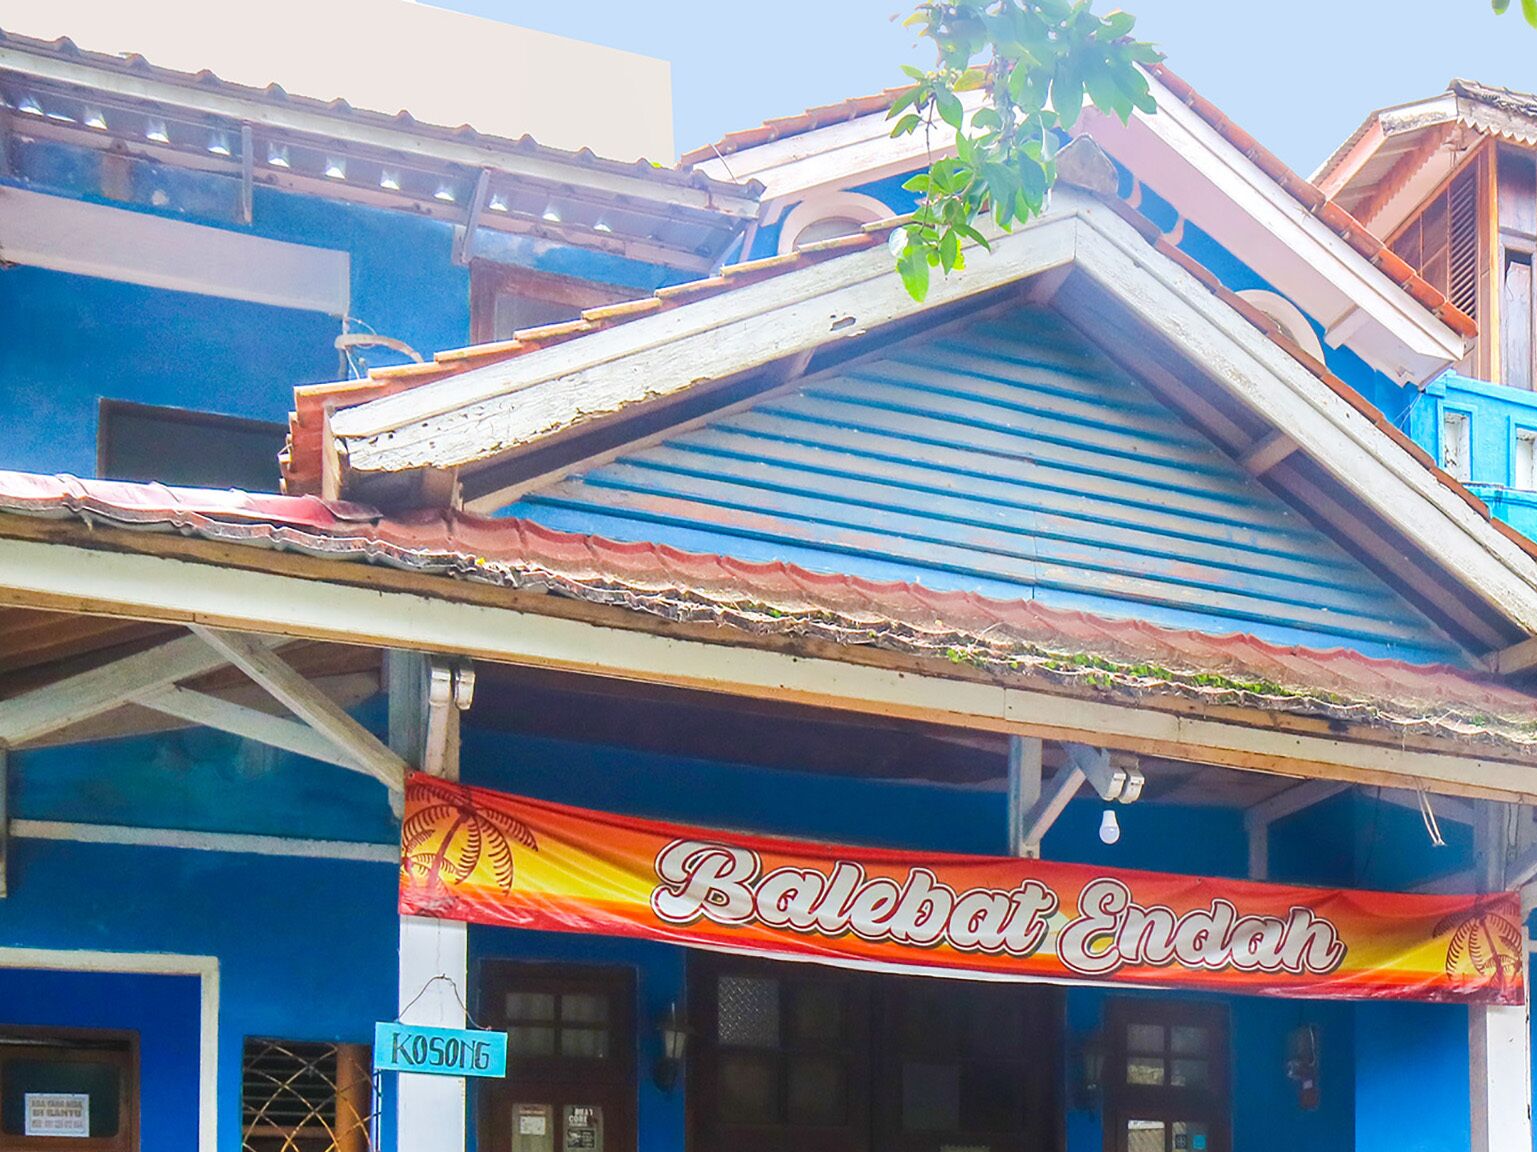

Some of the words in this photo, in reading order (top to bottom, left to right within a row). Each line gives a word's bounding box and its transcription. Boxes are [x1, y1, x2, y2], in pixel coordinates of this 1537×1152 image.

[650, 838, 1059, 957] Balebat
[1056, 877, 1348, 975] Endah
[391, 1032, 491, 1070] KOSONG
